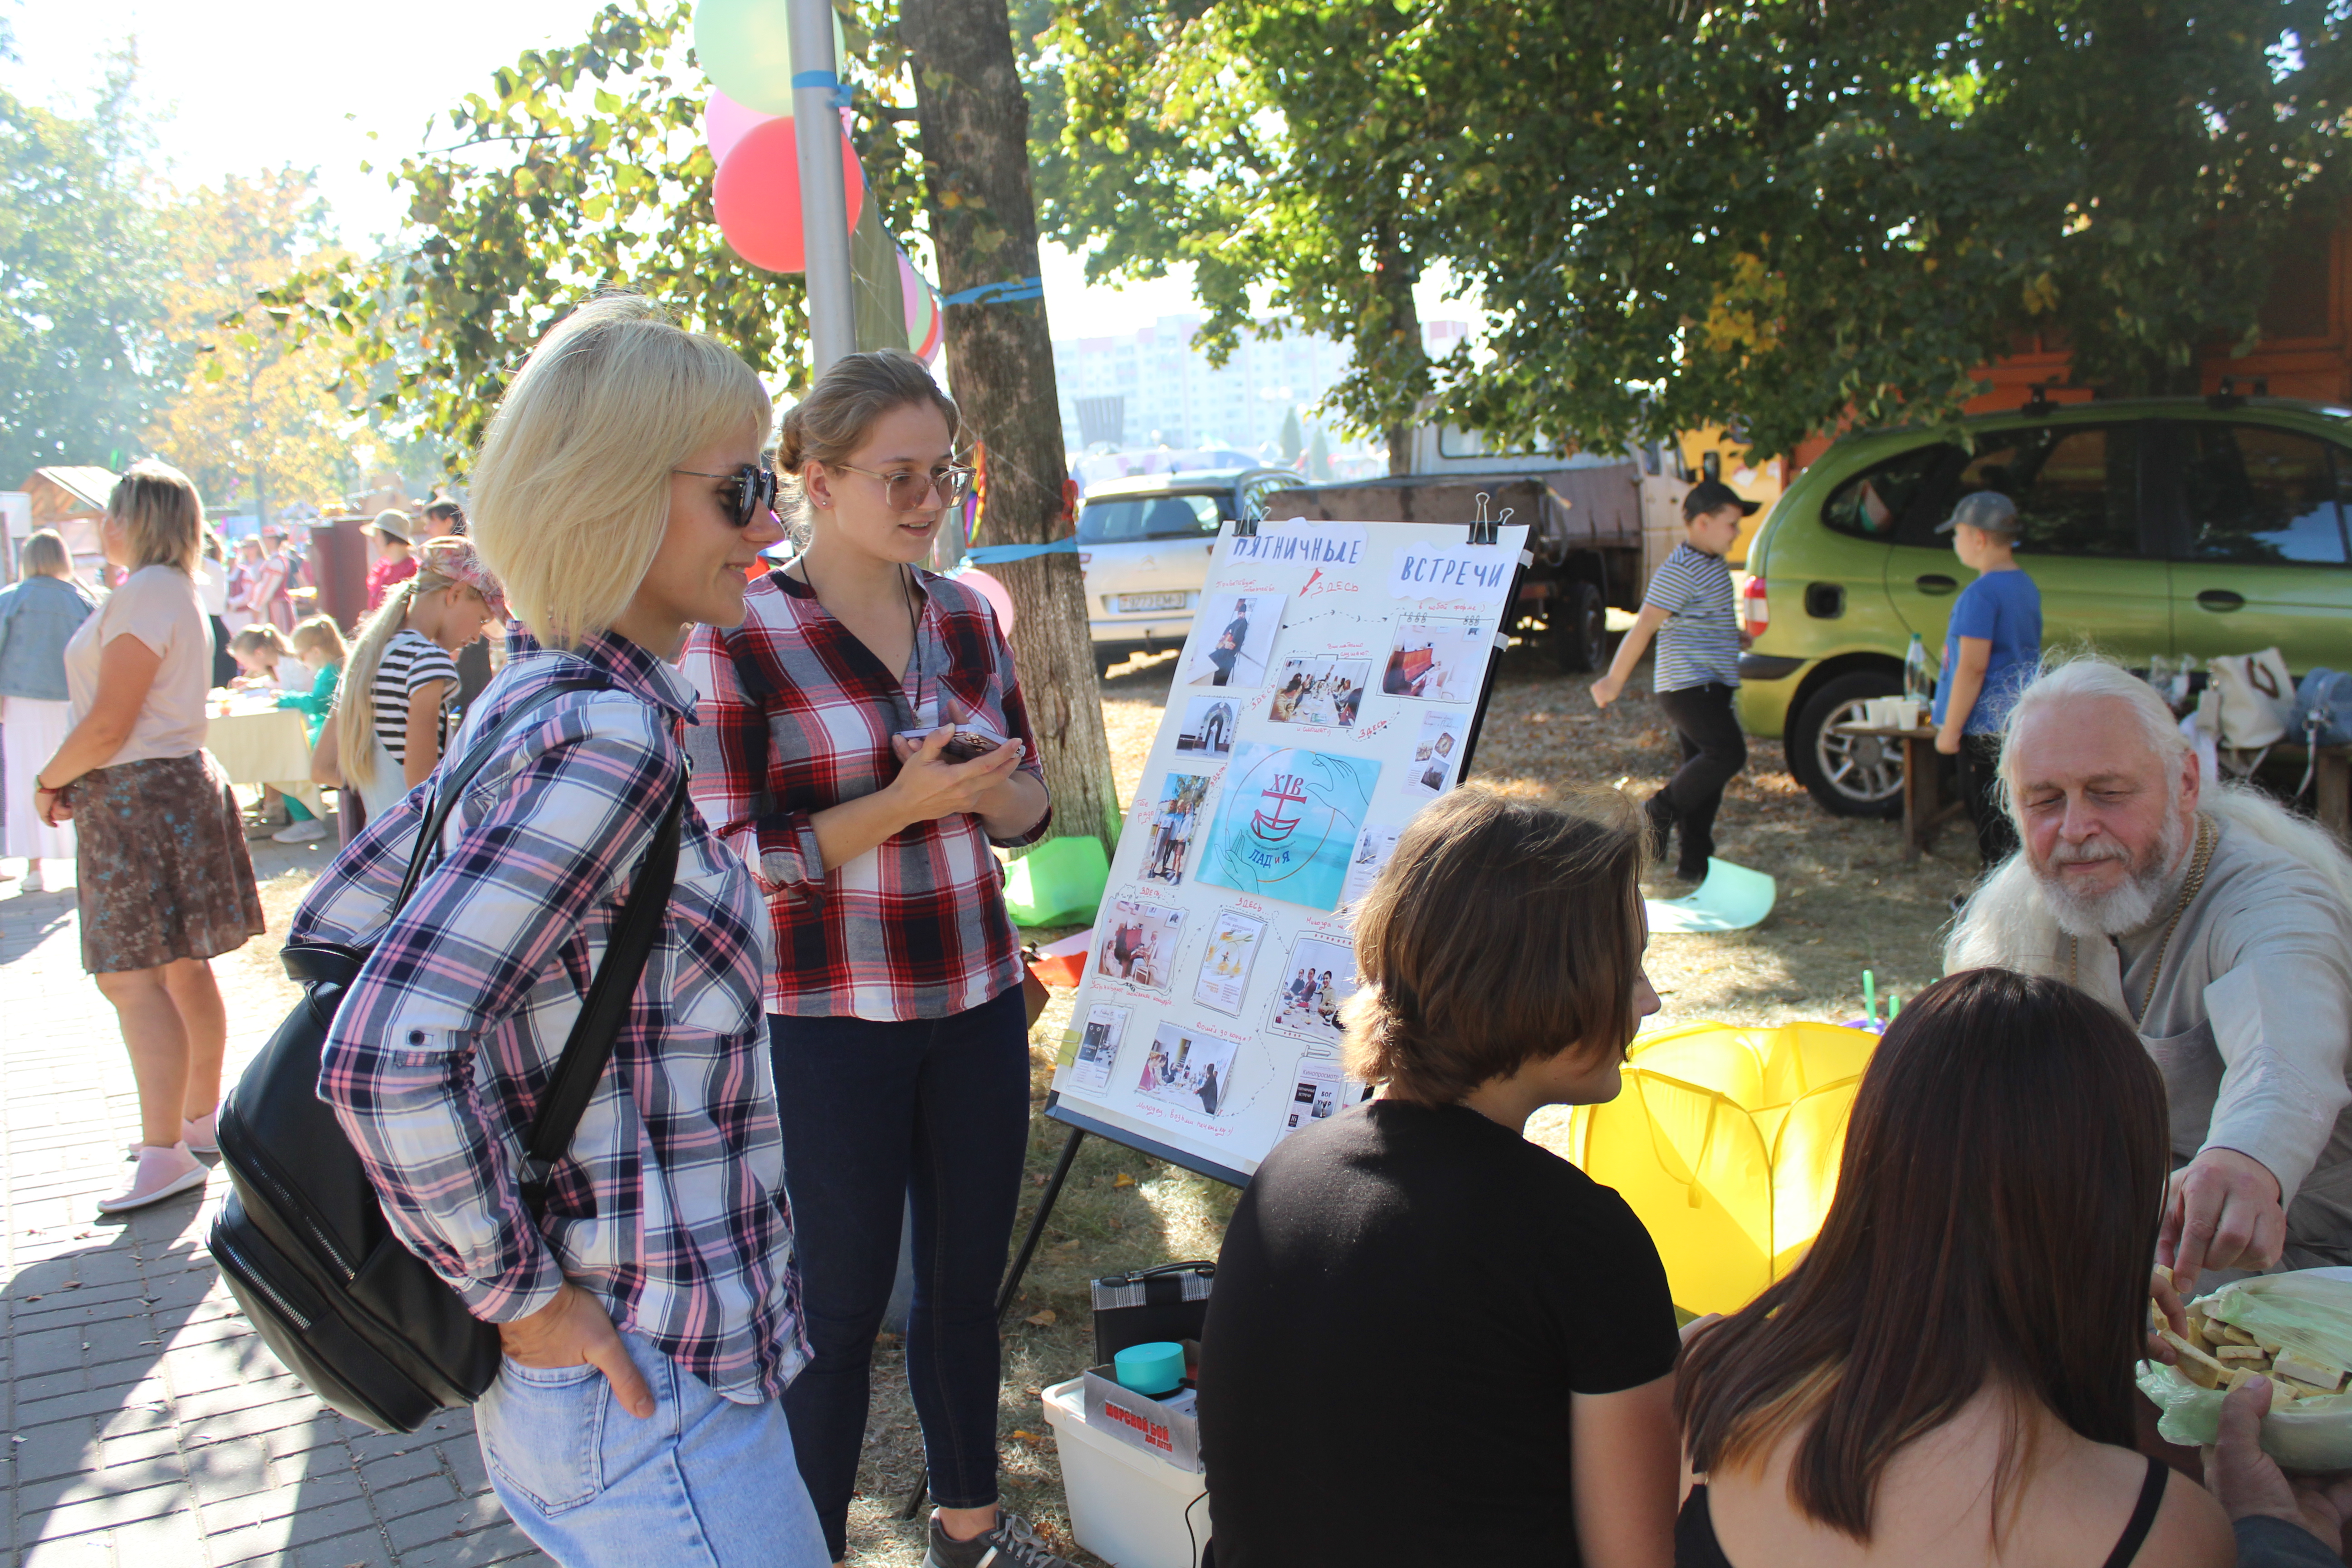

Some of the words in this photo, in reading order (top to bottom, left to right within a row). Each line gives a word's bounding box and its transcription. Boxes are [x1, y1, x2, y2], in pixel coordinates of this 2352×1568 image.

[1233, 535, 1361, 564] ПЯТНИЧНЫЕ
[1401, 556, 1505, 588] ВСТРЕЧИ
[1310, 581, 1358, 599] ЗДЕСЬ
[1302, 1069, 1339, 1081] Кинопросмотр
[1105, 1401, 1148, 1434] МОРСКОЙ
[1150, 1422, 1169, 1443] БОЙ
[1156, 1439, 1173, 1453] ДЕТЕЙ
